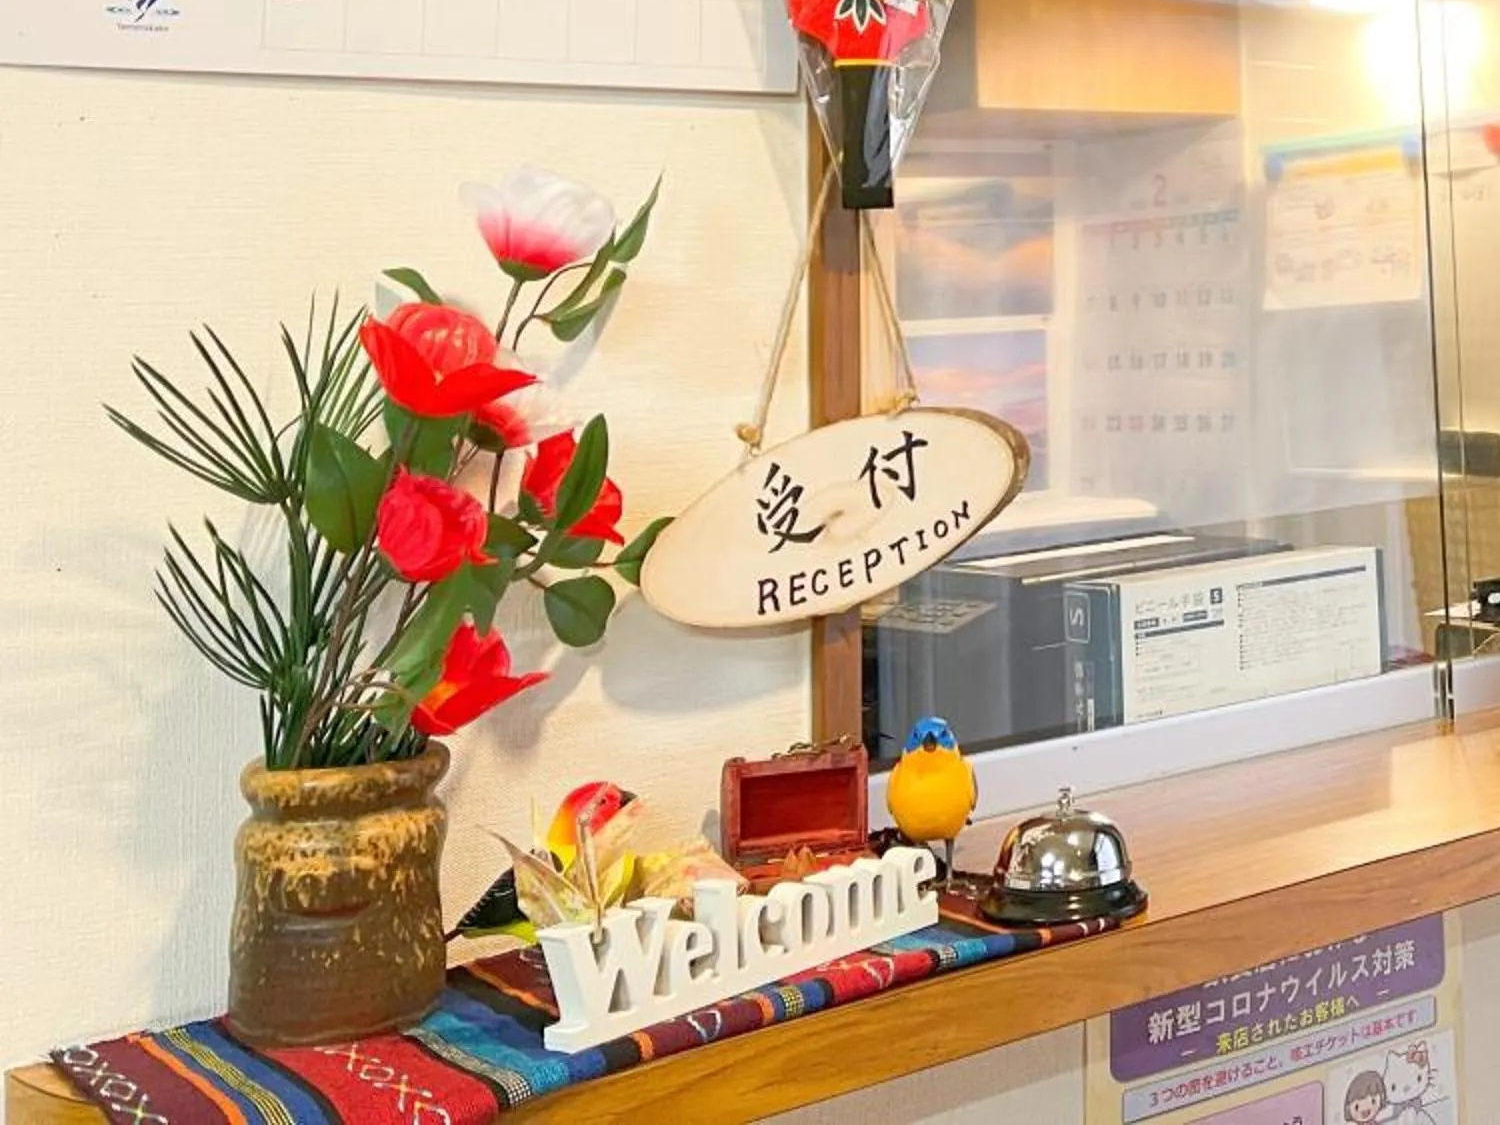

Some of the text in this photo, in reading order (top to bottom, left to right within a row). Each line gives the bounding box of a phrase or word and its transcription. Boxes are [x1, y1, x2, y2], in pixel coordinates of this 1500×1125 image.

[754, 429, 929, 553] 受付
[757, 499, 971, 616] RECEPTION
[537, 847, 938, 1040] Welcome
[1147, 939, 1417, 1045] 新型コロナウイルス対策
[1215, 993, 1360, 1056] 来店されたお客様へ
